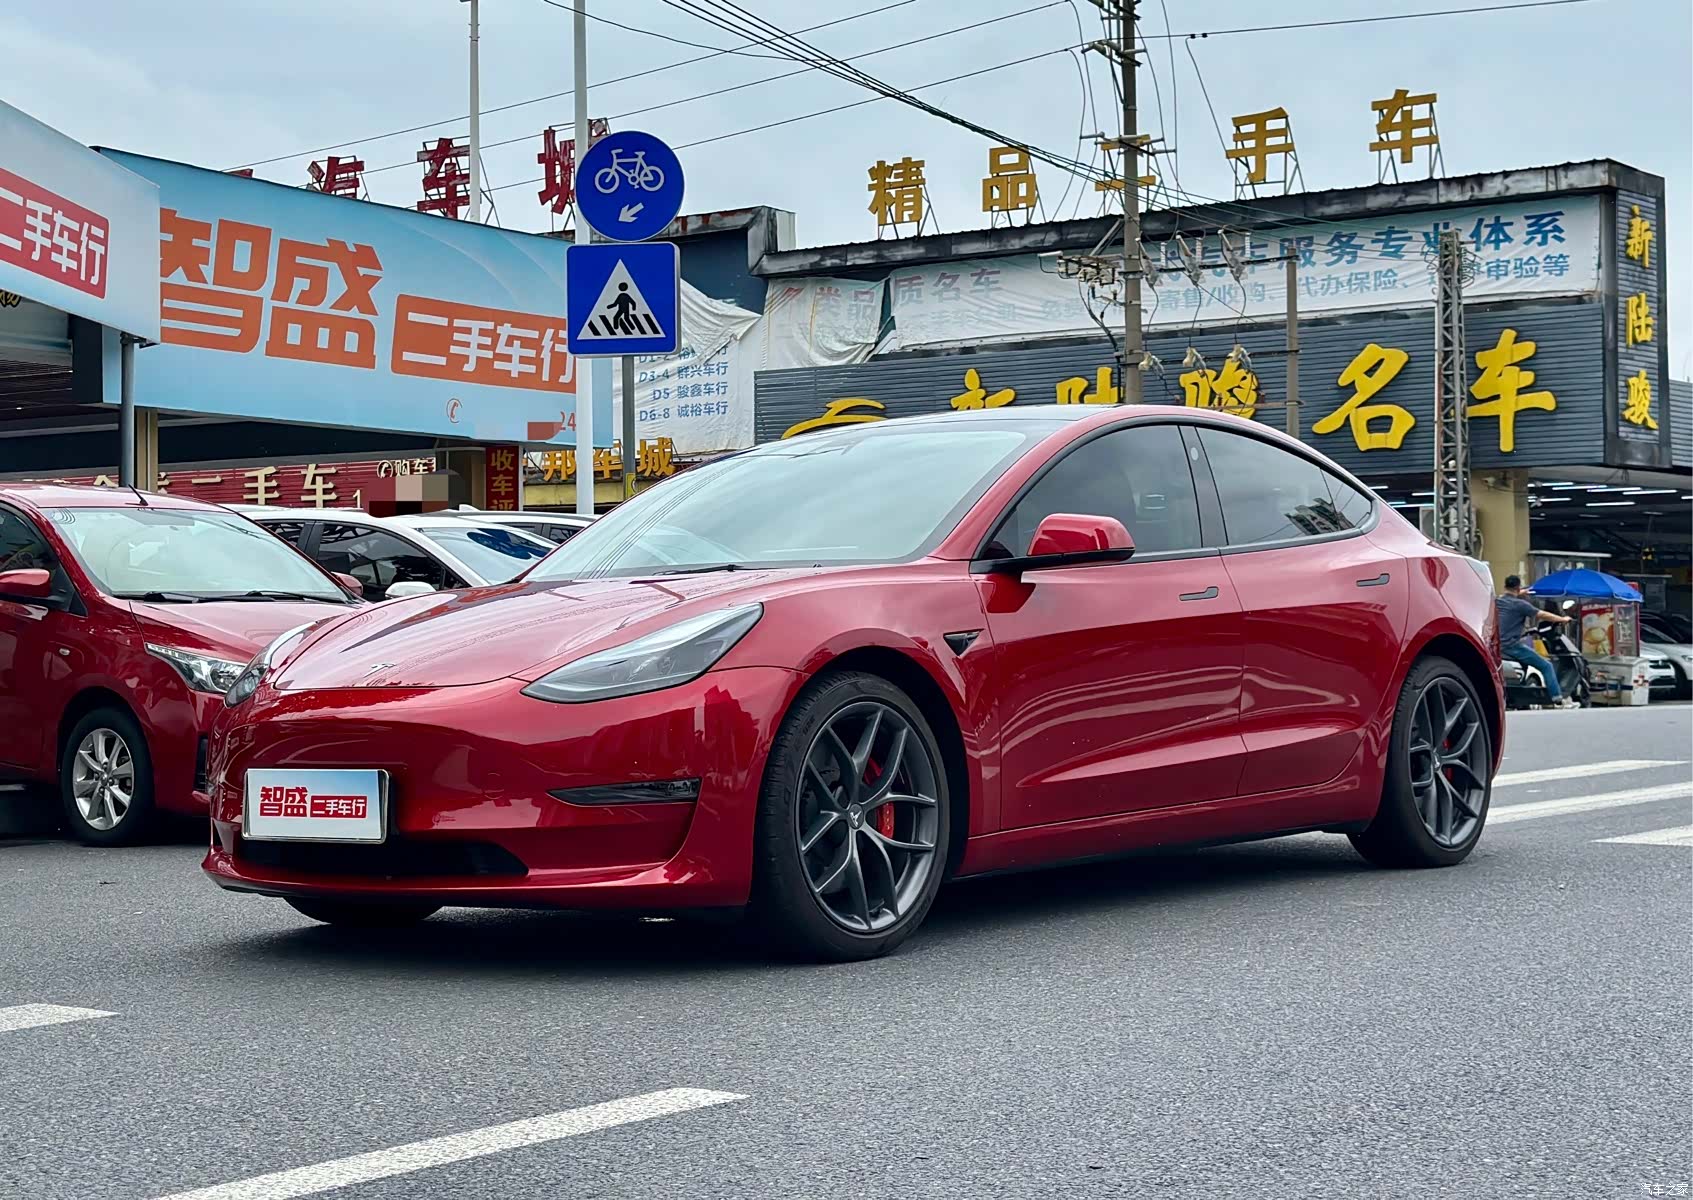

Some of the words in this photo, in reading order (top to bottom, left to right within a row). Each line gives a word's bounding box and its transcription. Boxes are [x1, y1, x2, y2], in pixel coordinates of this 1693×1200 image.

[868, 89, 1438, 226] 精品二手车
[0, 186, 105, 286] 二手车行
[160, 208, 383, 370] 智盛
[404, 312, 576, 383] 二手车行
[1623, 204, 1659, 430] 新陆骏
[639, 369, 670, 383] D3-4
[652, 388, 670, 401] D5
[639, 407, 670, 422] D6-8
[260, 786, 308, 818] 智盛
[312, 798, 366, 816] 二手车行
